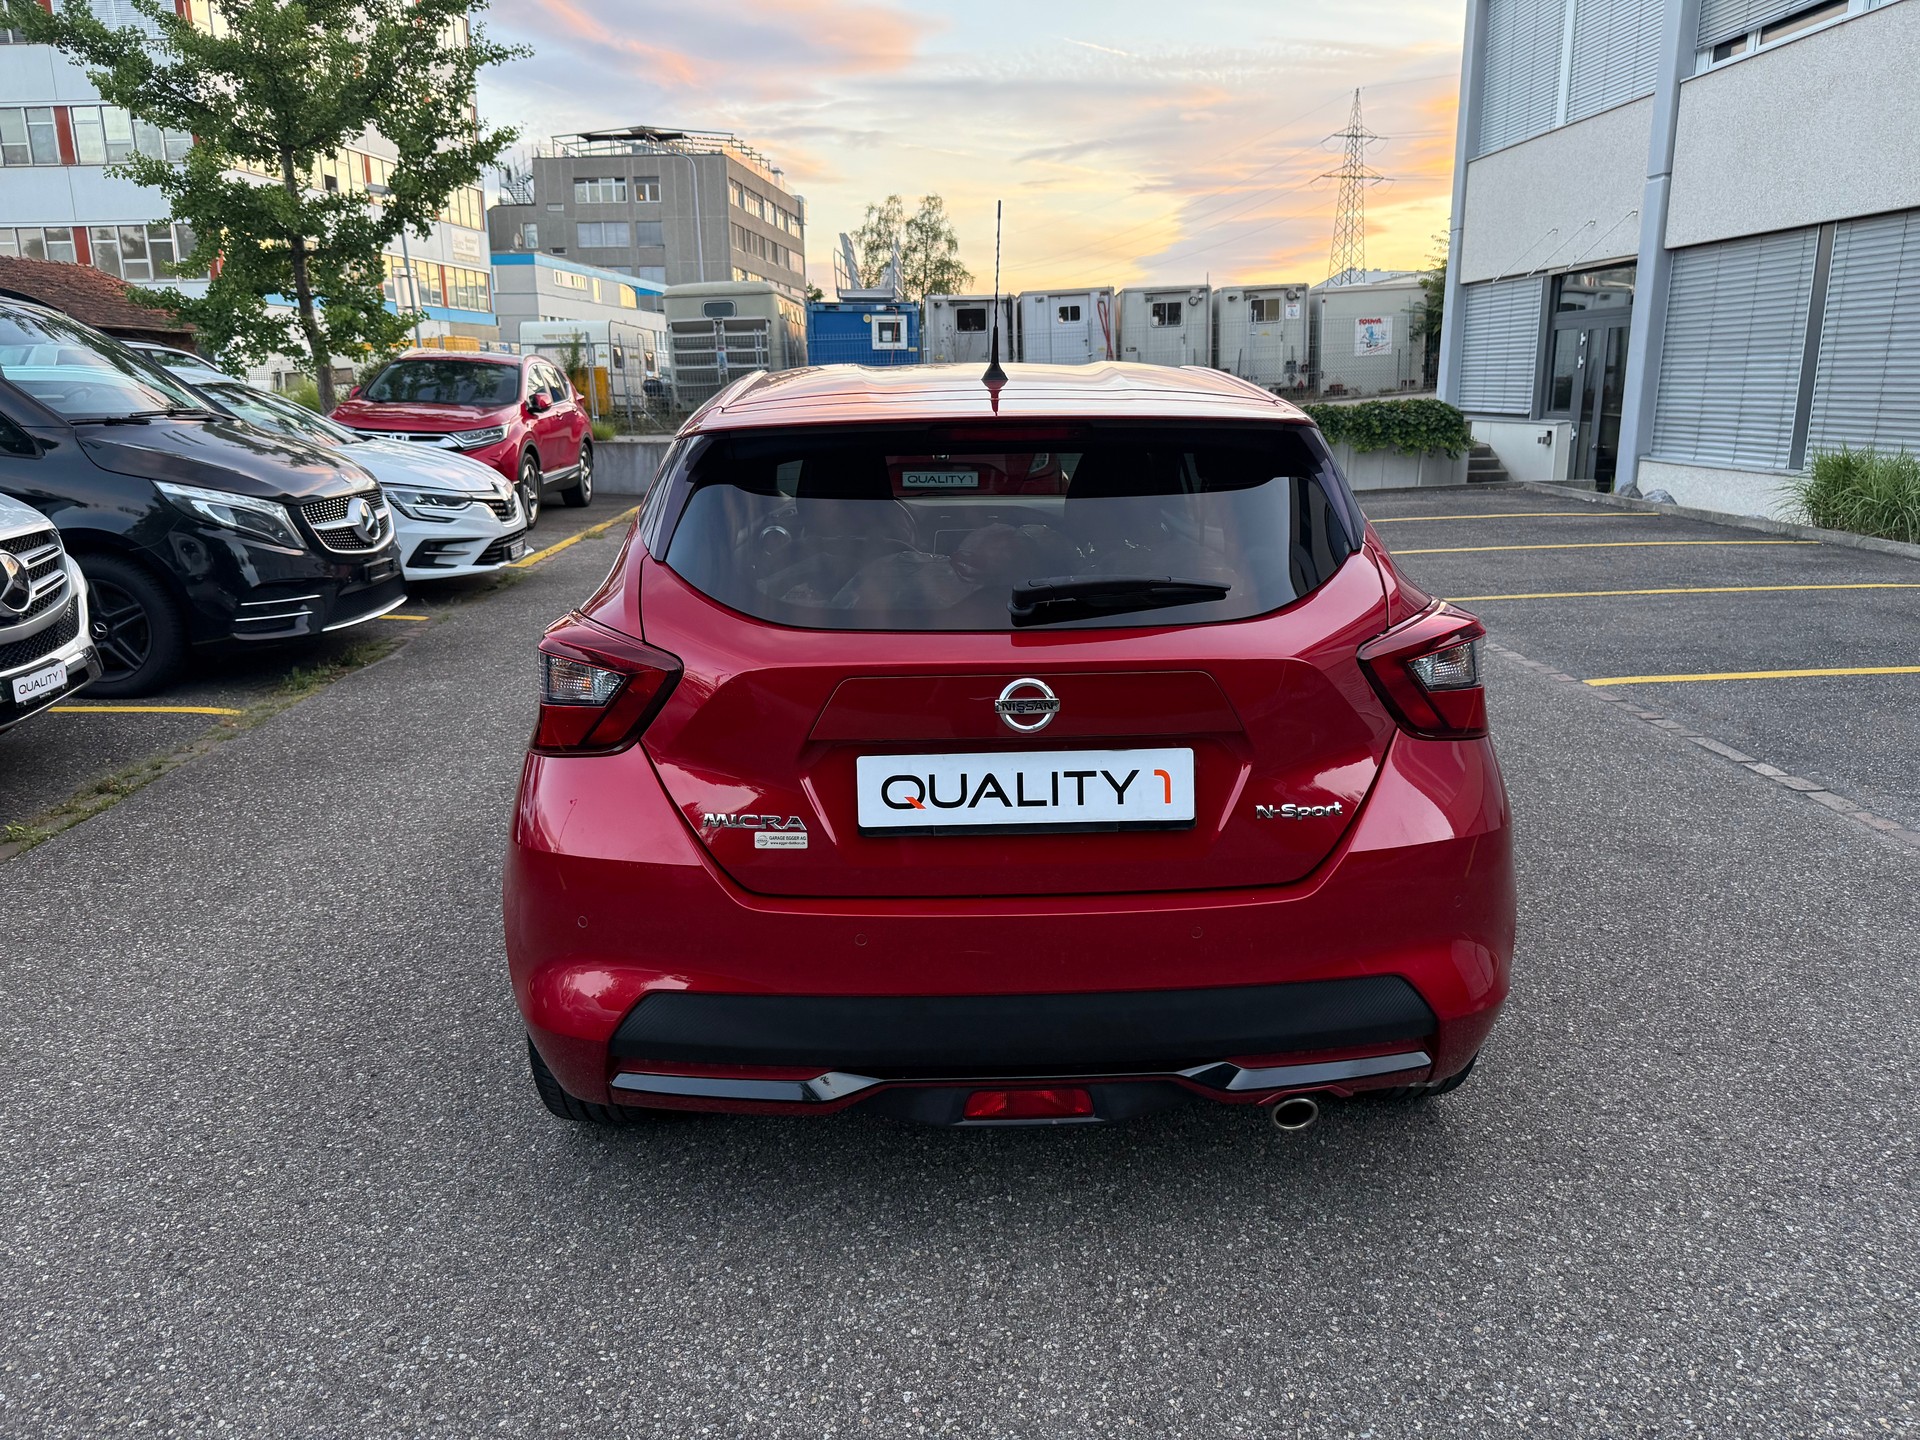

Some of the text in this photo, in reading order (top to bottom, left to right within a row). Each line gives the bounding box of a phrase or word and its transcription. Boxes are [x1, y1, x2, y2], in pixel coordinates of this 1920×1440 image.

[907, 475, 966, 483] QUALITY
[19, 671, 58, 694] QUALITY
[1000, 700, 1054, 712] NISSAN
[880, 769, 1172, 810] QUALITY 1
[1255, 801, 1343, 821] N-Sport
[702, 812, 808, 831] MICRA
